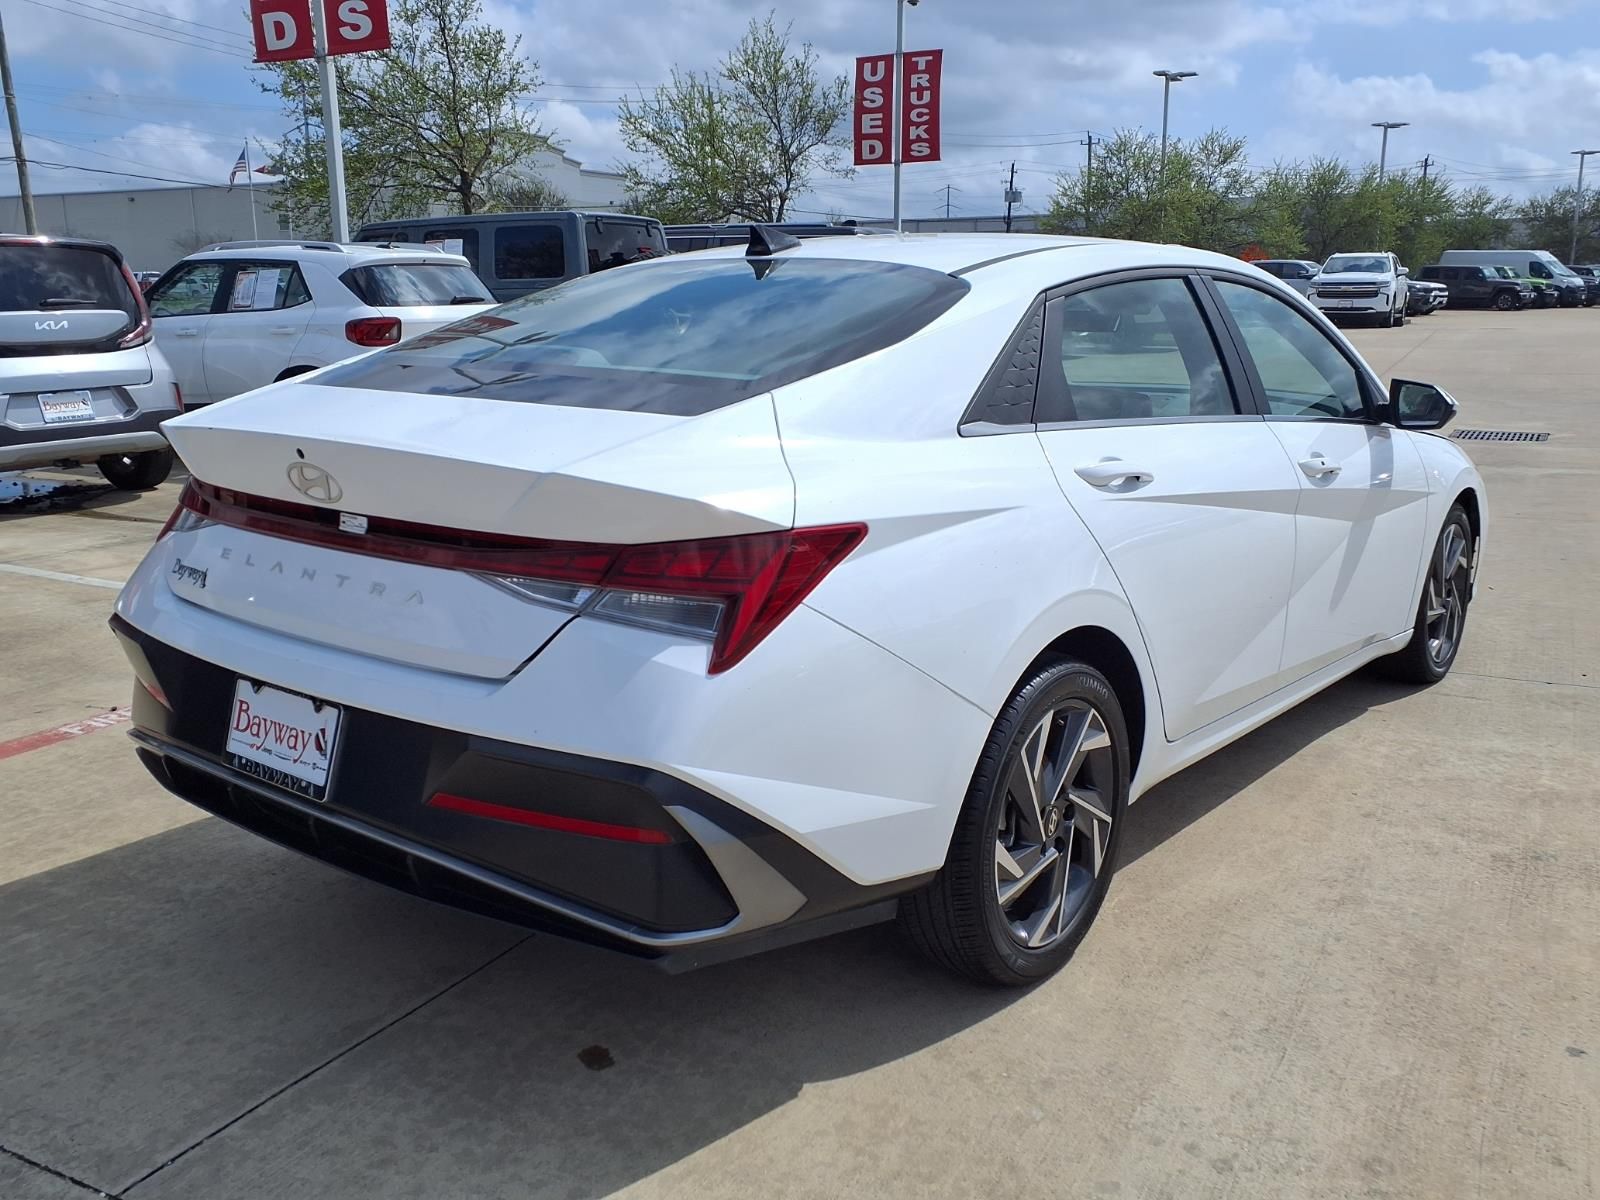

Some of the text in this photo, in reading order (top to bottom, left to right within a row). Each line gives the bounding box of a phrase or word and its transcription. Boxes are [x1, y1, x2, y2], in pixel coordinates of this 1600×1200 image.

[862, 61, 885, 160] USED
[909, 56, 933, 156] TRUCKS
[43, 401, 80, 412] Bayway
[172, 558, 205, 587] Bayway
[220, 547, 424, 604] ELANTRA
[233, 699, 313, 764] Bayway
[245, 761, 302, 791] BAYWAY
